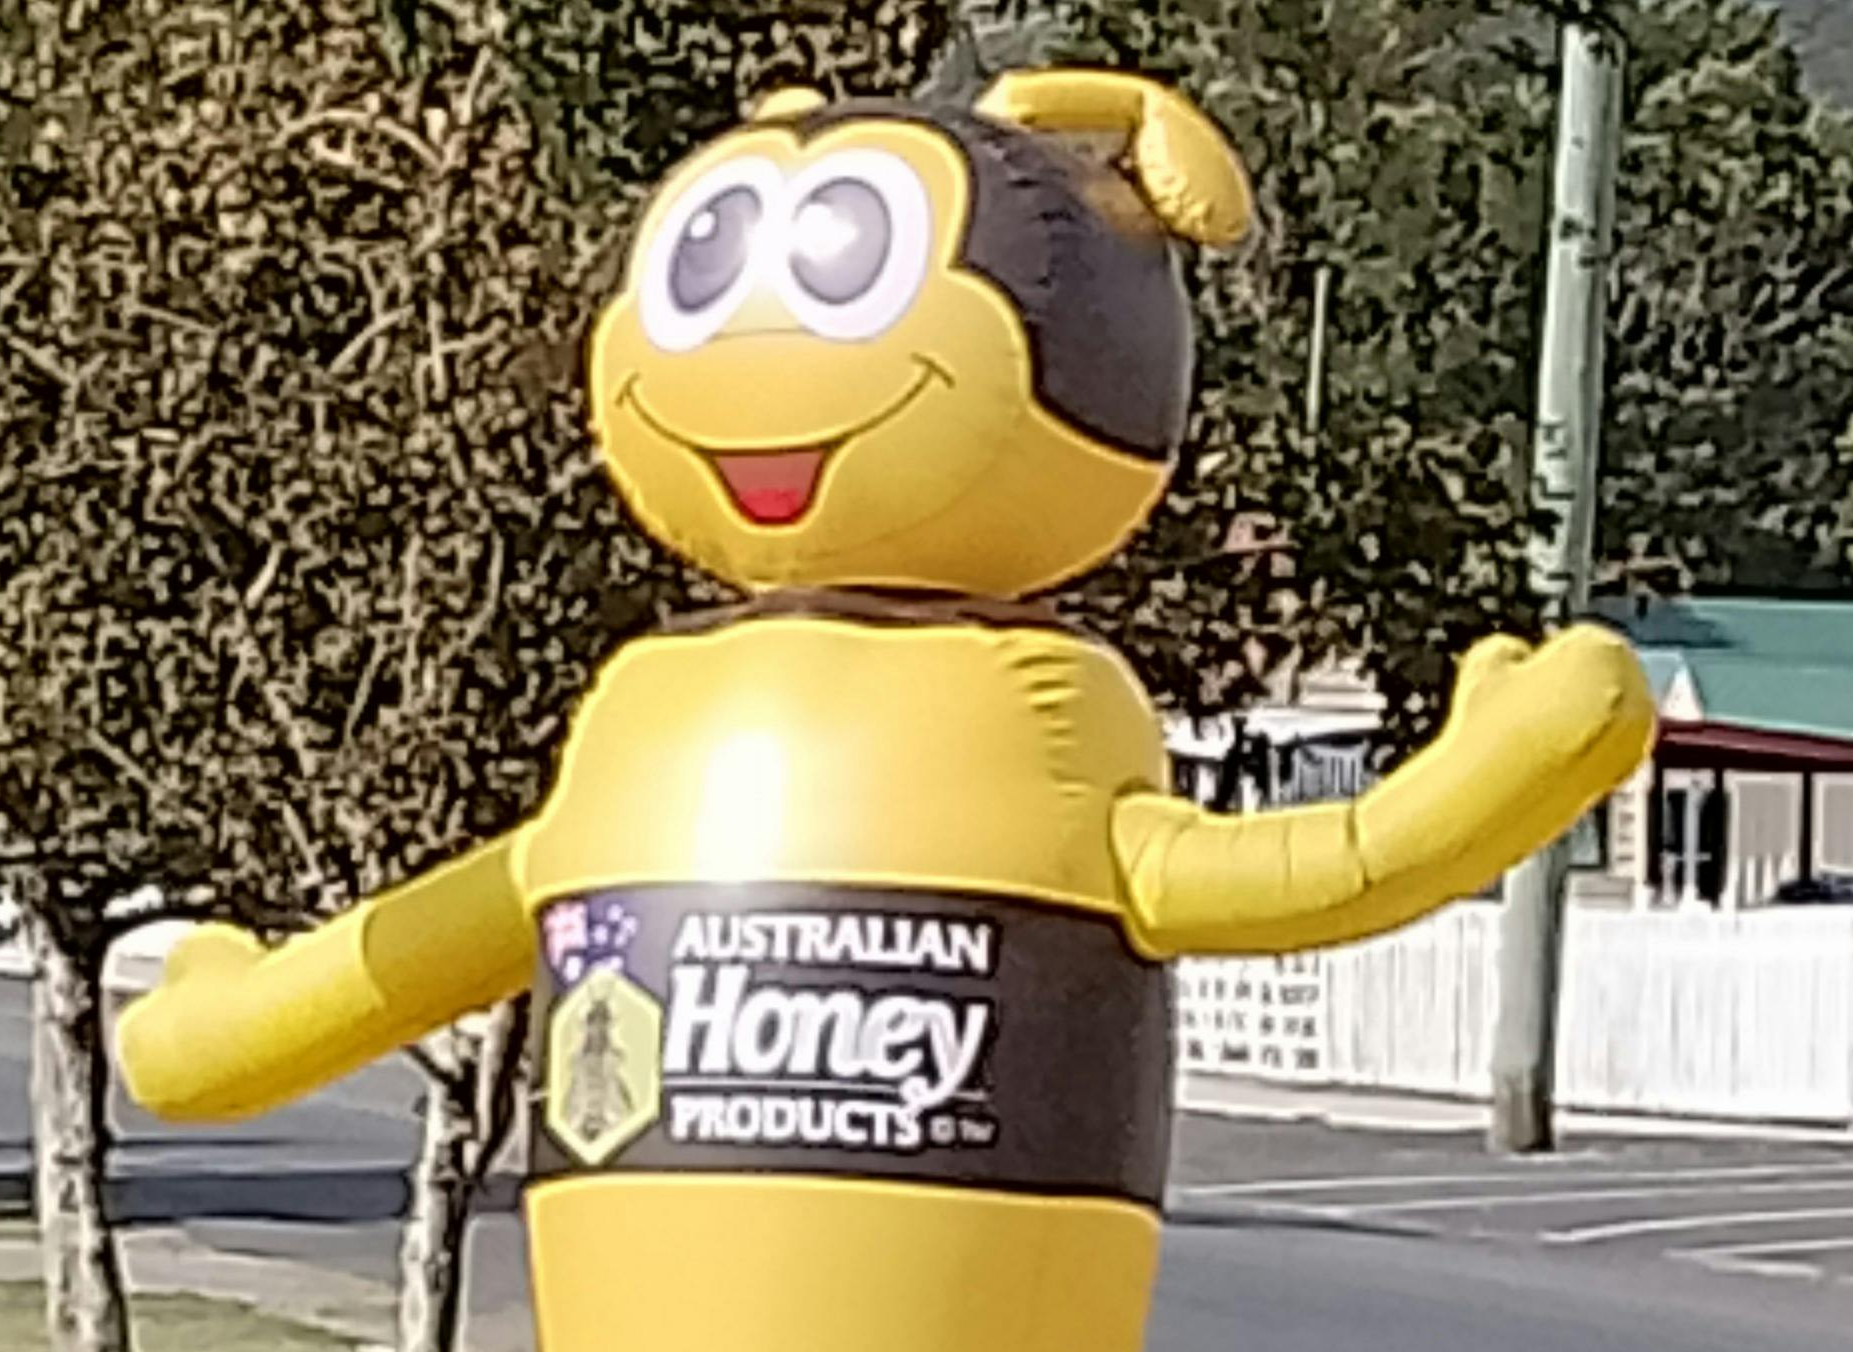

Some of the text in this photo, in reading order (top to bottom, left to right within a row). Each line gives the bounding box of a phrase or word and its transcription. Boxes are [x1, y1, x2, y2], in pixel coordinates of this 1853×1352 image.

[675, 914, 991, 970] AUSTRALIAN
[664, 964, 988, 1108] Honey
[671, 1097, 921, 1146] PRODUCTS
